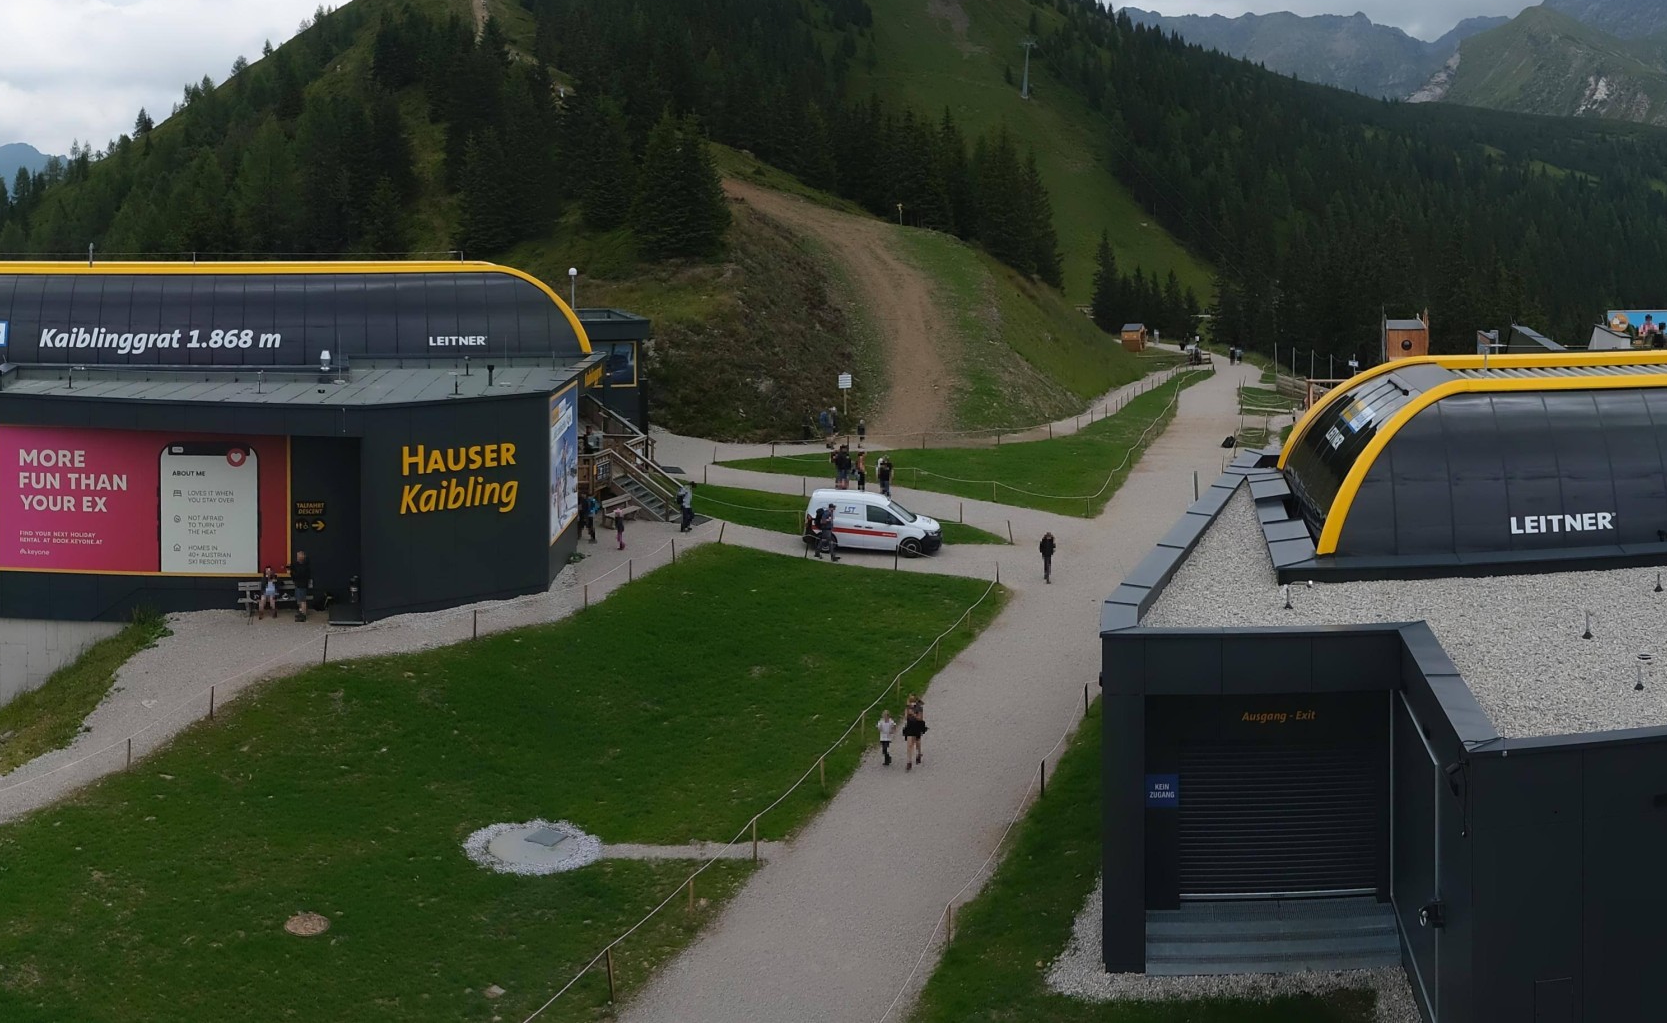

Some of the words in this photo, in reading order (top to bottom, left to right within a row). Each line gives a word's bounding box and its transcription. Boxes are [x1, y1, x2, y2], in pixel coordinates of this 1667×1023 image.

[39, 327, 181, 354] Kaiblinggrat
[186, 329, 254, 348] 1.868
[259, 333, 281, 348] m
[19, 449, 85, 468] MORE
[402, 442, 517, 476] HAUSER
[19, 471, 60, 489] FUN
[67, 473, 127, 491] THAN
[20, 494, 76, 512] YOUR
[82, 496, 108, 513] EX
[399, 476, 519, 515] Kaibling
[1510, 512, 1614, 534] LEITNER
[1241, 711, 1287, 723] Ausgang
[1295, 709, 1316, 720] Exit
[1149, 791, 1175, 799] ZUGANG
